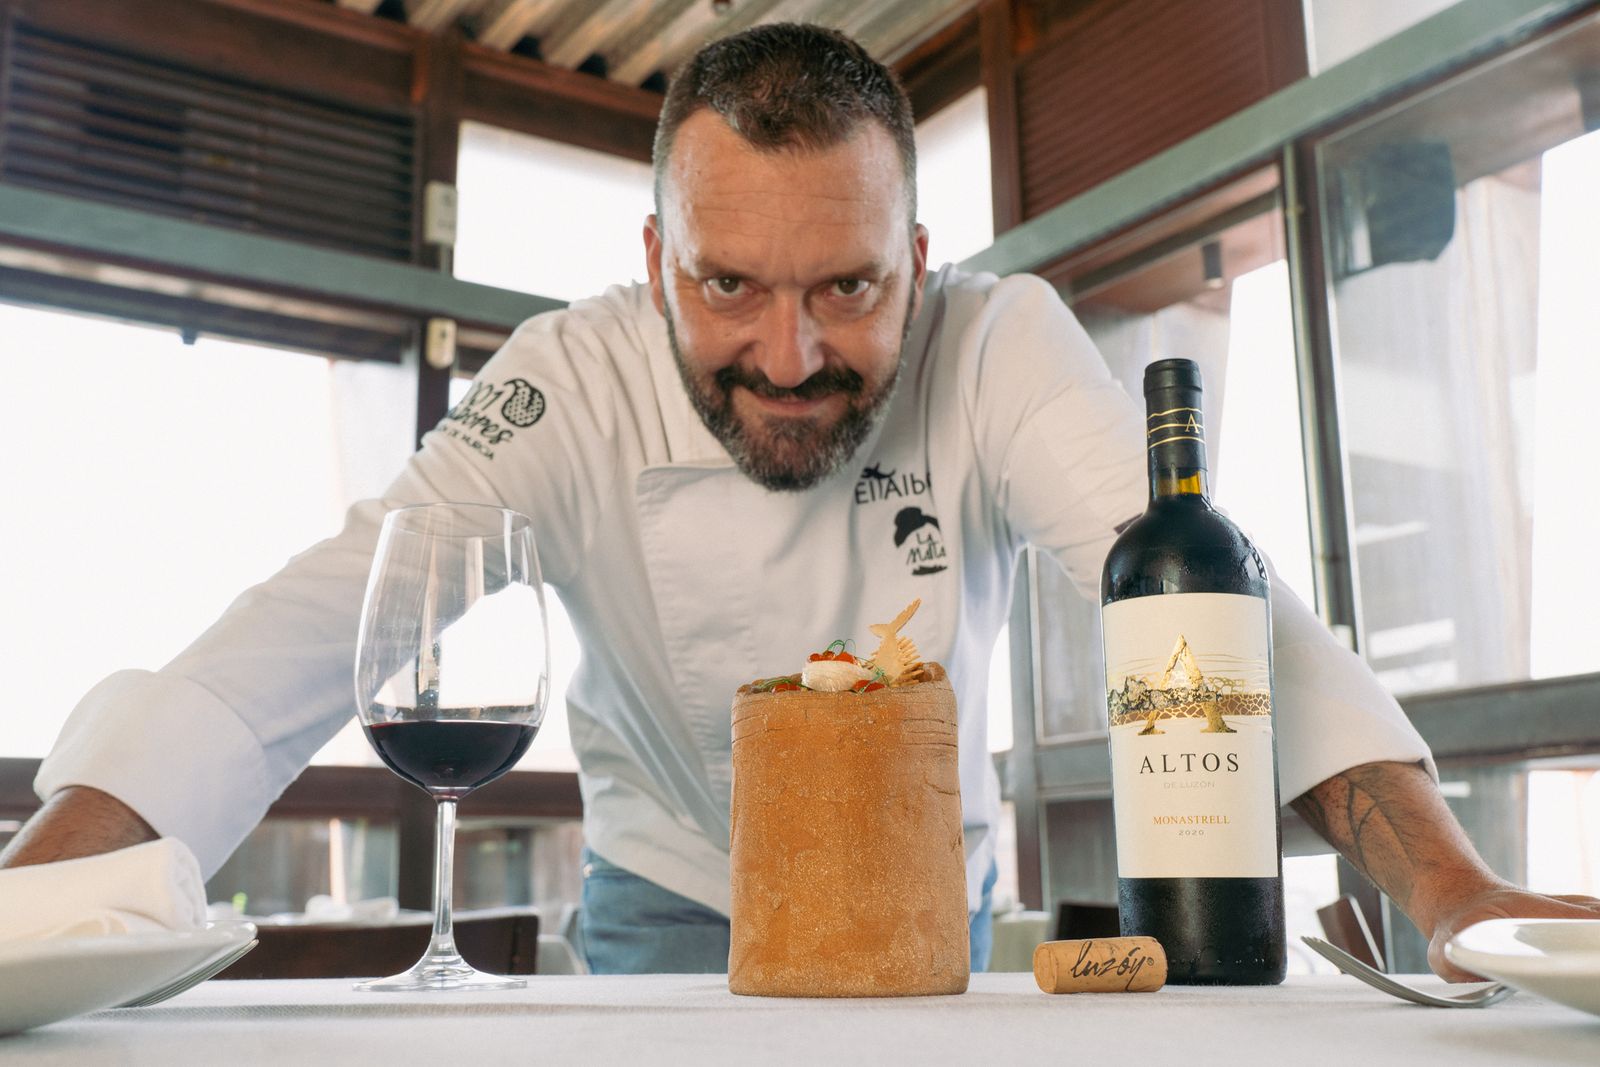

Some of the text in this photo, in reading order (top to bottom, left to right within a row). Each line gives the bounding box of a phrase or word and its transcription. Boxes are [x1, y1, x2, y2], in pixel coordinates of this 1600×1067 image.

[1184, 412, 1200, 434] A
[1139, 752, 1240, 775] ALTOS
[1163, 781, 1176, 789] DE
[1152, 815, 1230, 825] MONASTRELL
